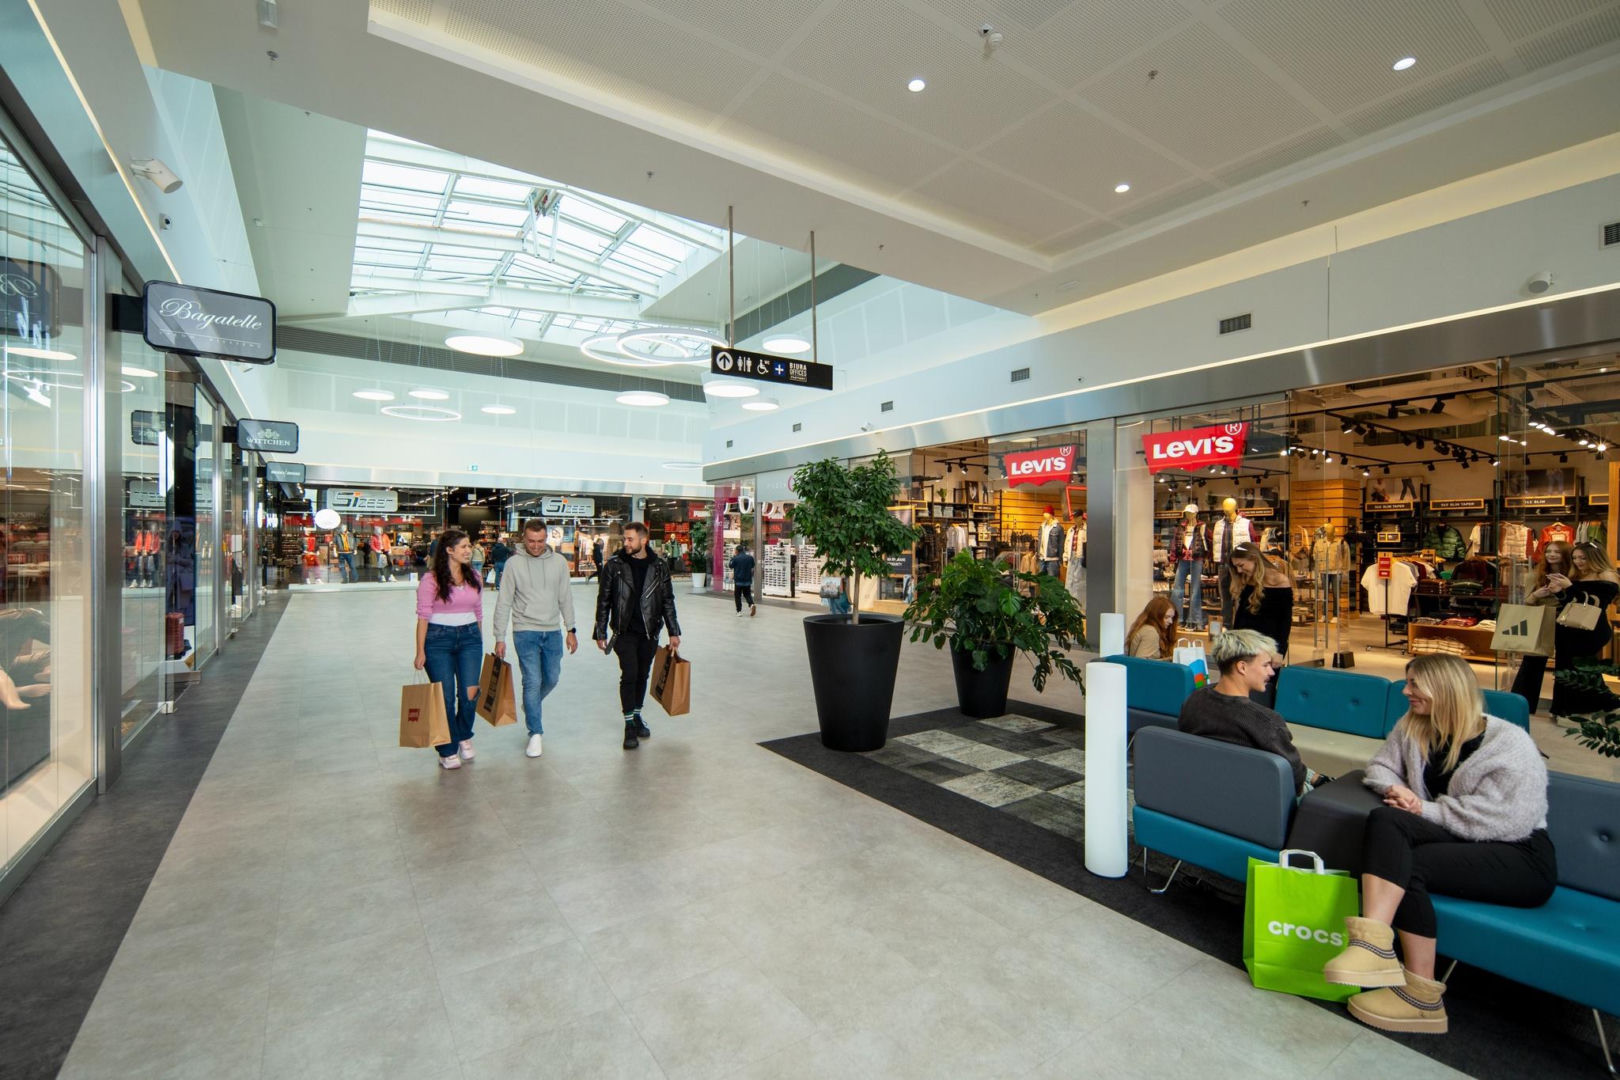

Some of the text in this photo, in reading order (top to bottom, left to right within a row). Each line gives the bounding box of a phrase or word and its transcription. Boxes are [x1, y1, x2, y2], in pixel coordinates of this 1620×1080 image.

[159, 297, 265, 331] Bagatelle
[788, 362, 807, 370] BIURA
[246, 436, 291, 446] WITTCHEN
[1267, 919, 1344, 947] crocs
